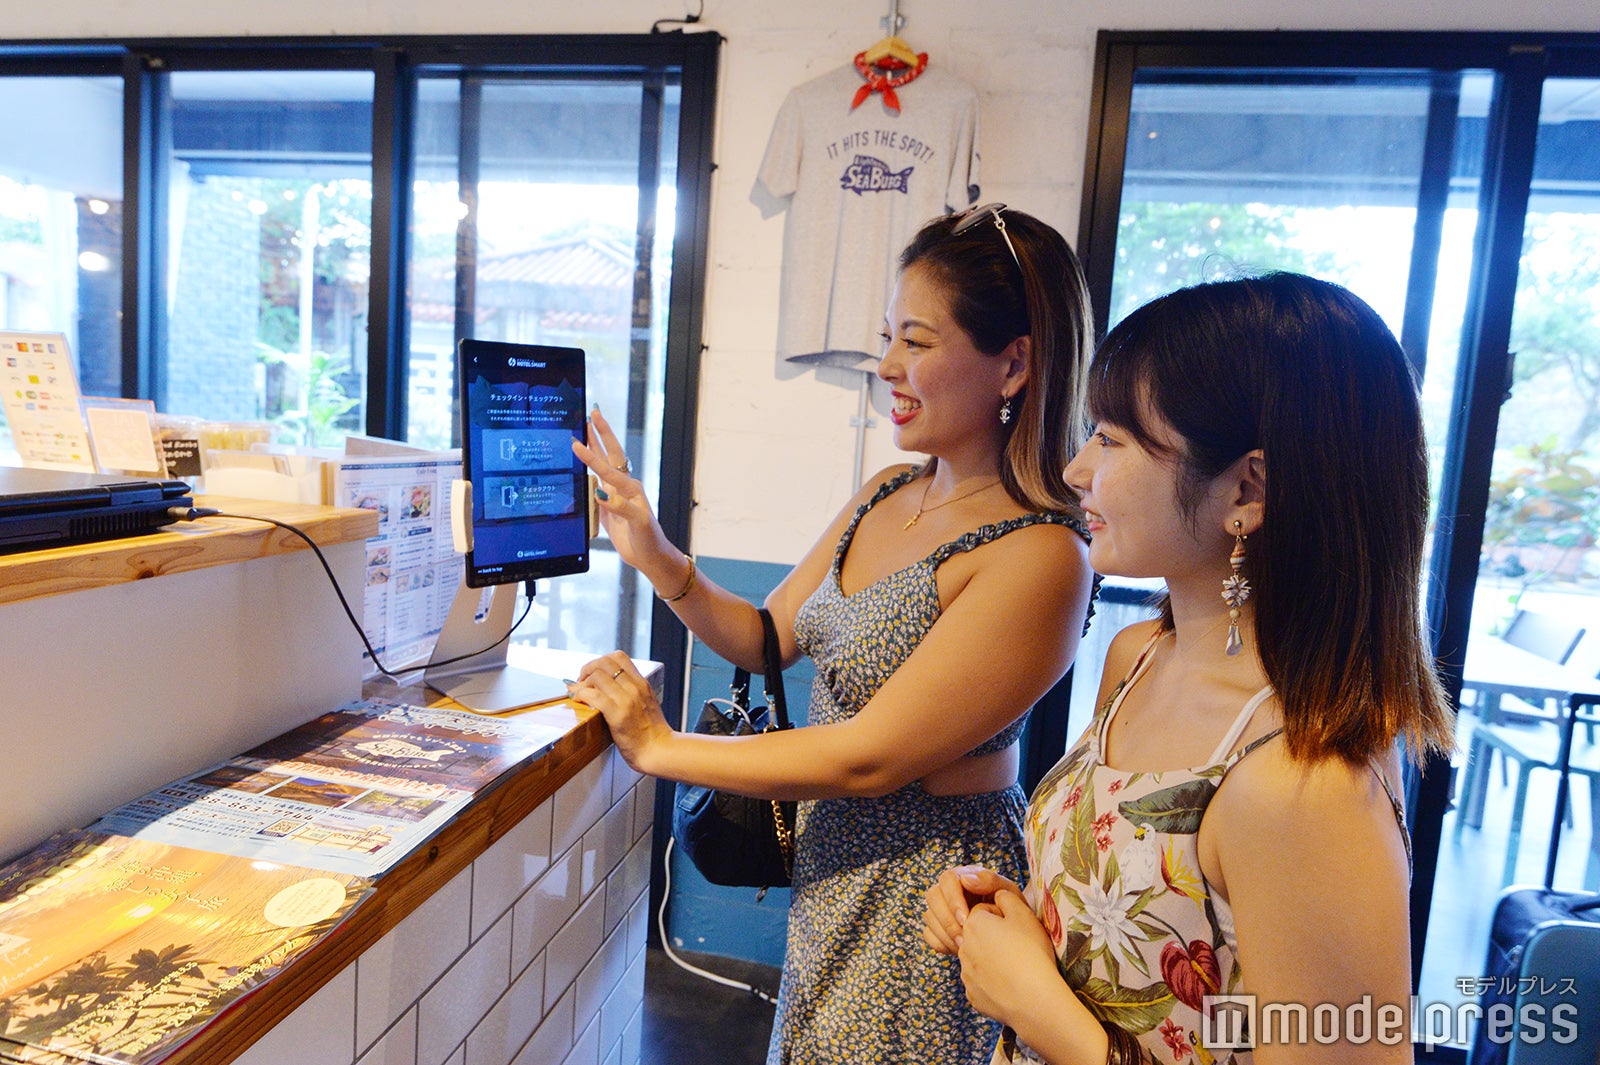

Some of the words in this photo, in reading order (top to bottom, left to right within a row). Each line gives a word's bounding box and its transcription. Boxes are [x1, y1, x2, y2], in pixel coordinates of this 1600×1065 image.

[826, 142, 839, 160] IT
[842, 131, 869, 152] HITS
[874, 130, 898, 149] THE
[899, 135, 936, 164] SPOT!
